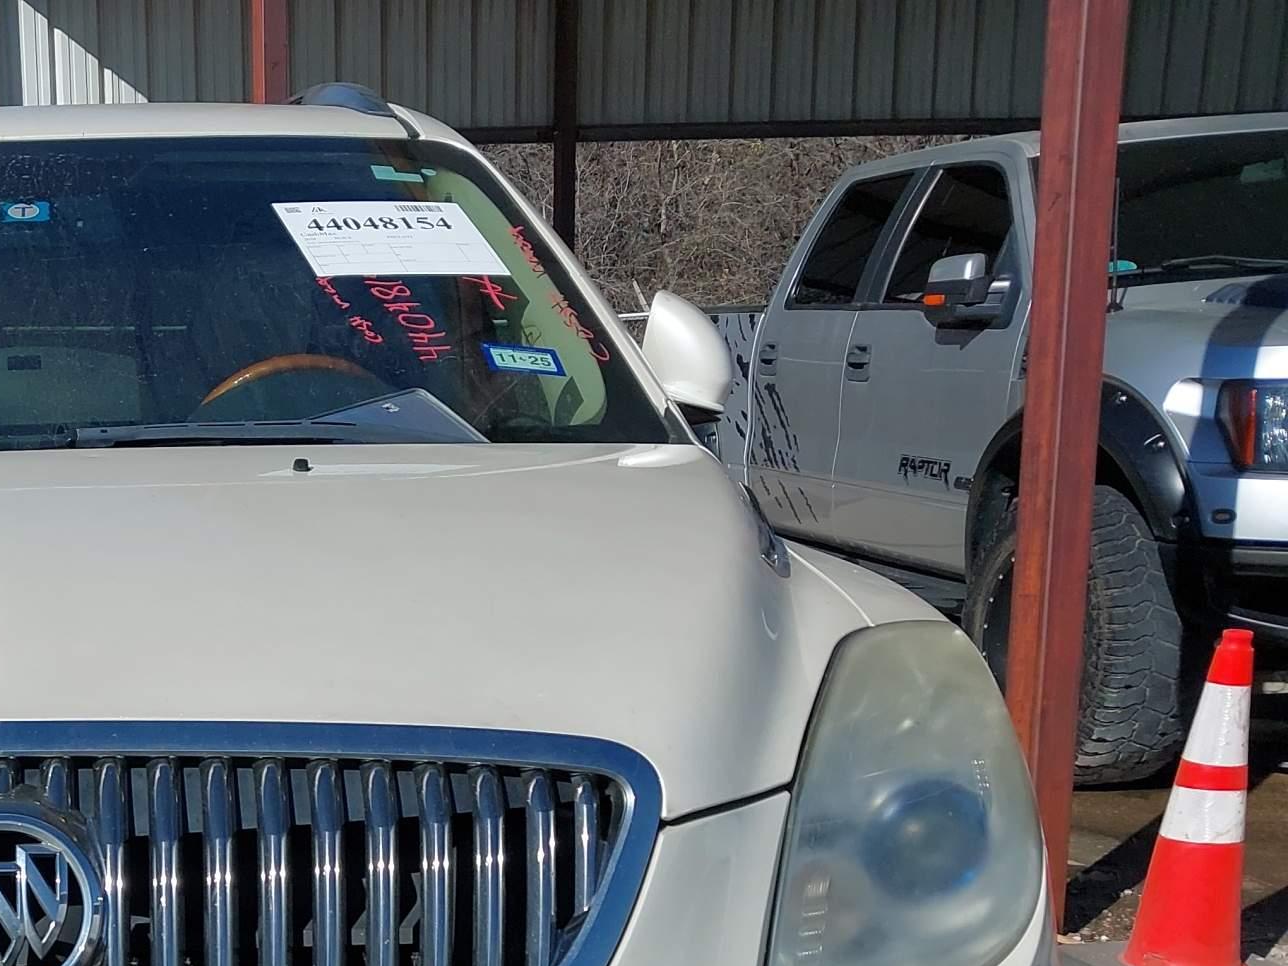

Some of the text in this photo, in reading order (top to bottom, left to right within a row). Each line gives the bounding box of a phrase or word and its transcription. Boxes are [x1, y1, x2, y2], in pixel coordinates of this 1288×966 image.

[306, 215, 453, 231] 44048154
[362, 275, 452, 362] 440481
[897, 454, 952, 491] RAPTOR
